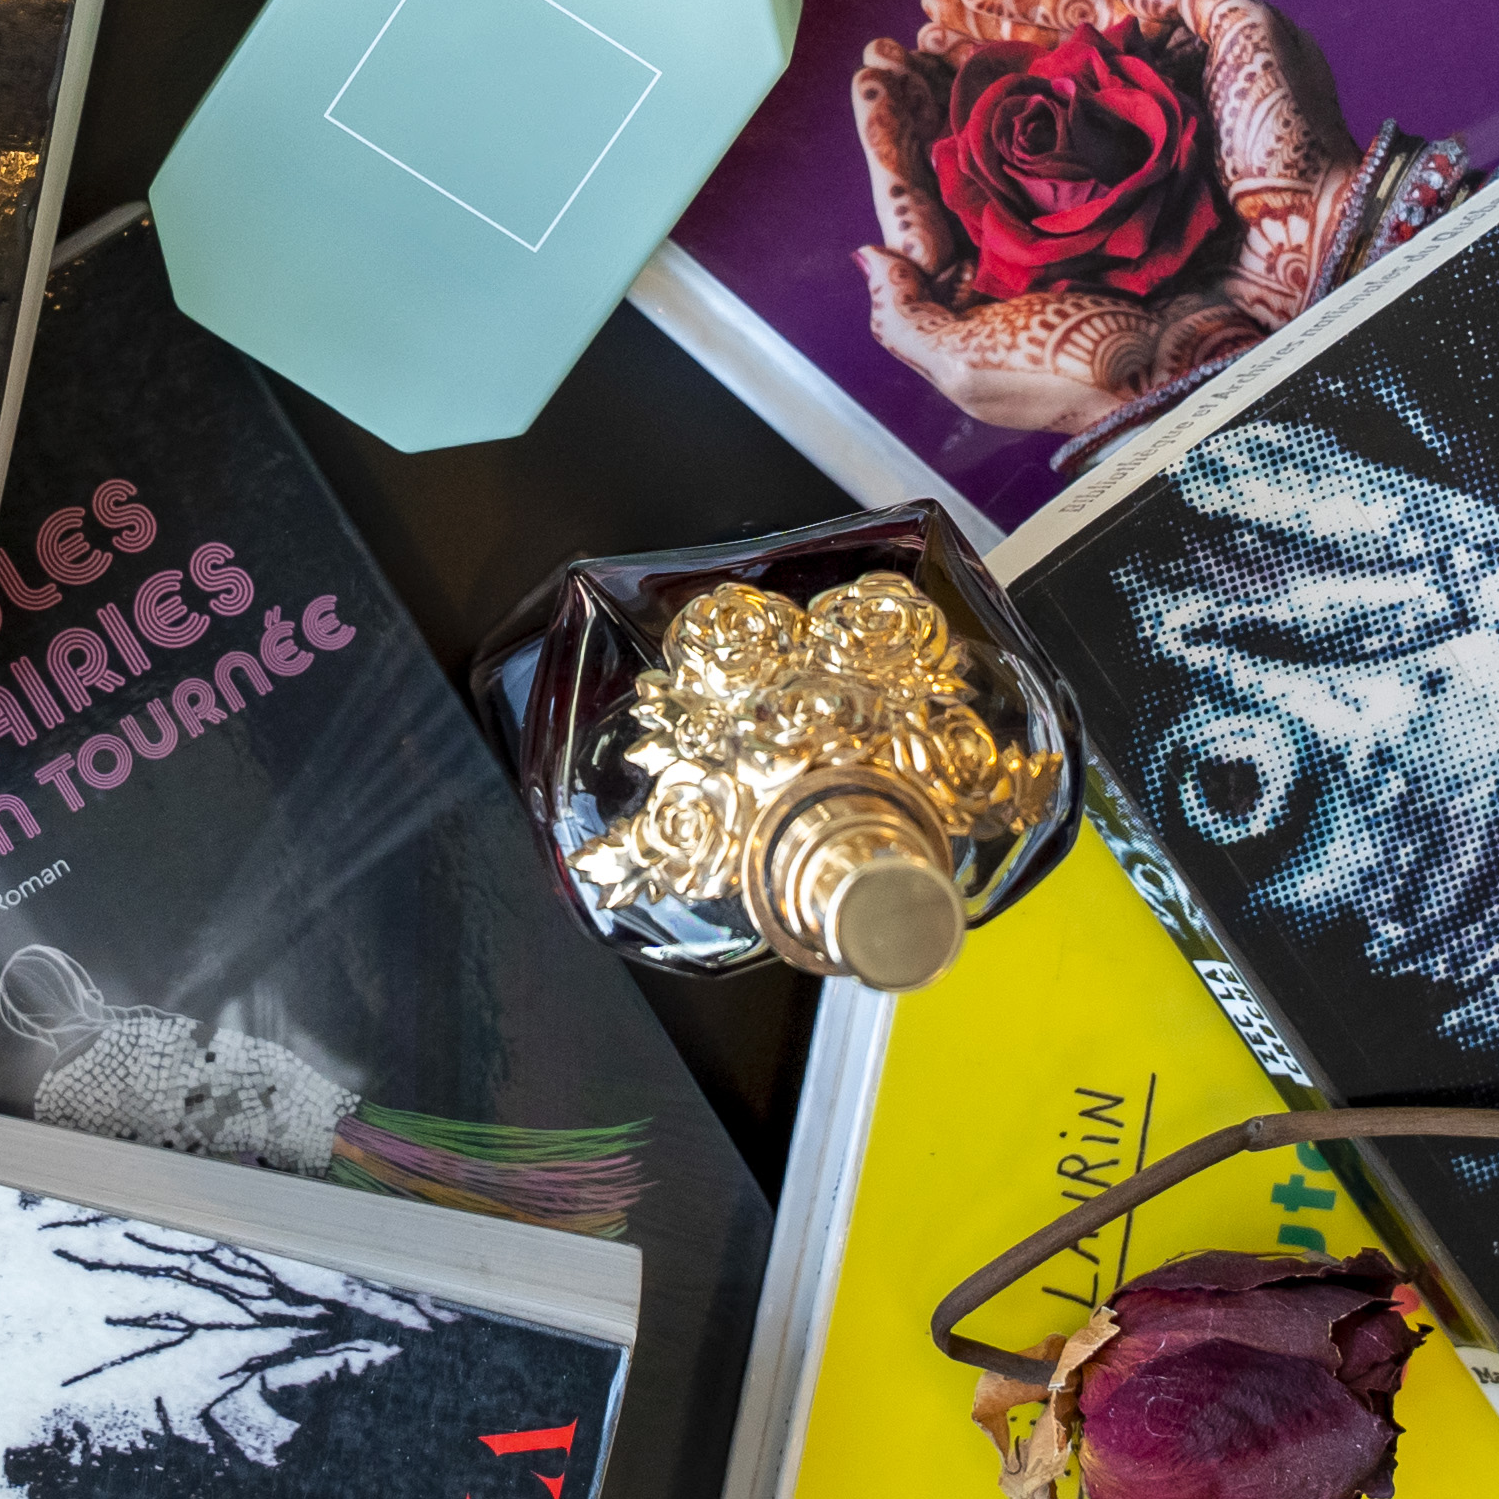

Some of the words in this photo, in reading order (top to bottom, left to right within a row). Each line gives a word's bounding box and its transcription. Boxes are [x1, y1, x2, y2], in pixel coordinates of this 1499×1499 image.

[1059, 419, 1194, 515] Bibliothèque
[1211, 338, 1306, 401] Archives
[1299, 263, 1411, 343] nationales
[35, 593, 357, 814] TOURNÉE
[1203, 968, 1237, 1000] LA
[1219, 967, 1303, 1075] CROCHE
[1233, 1013, 1281, 1064] ZEC
